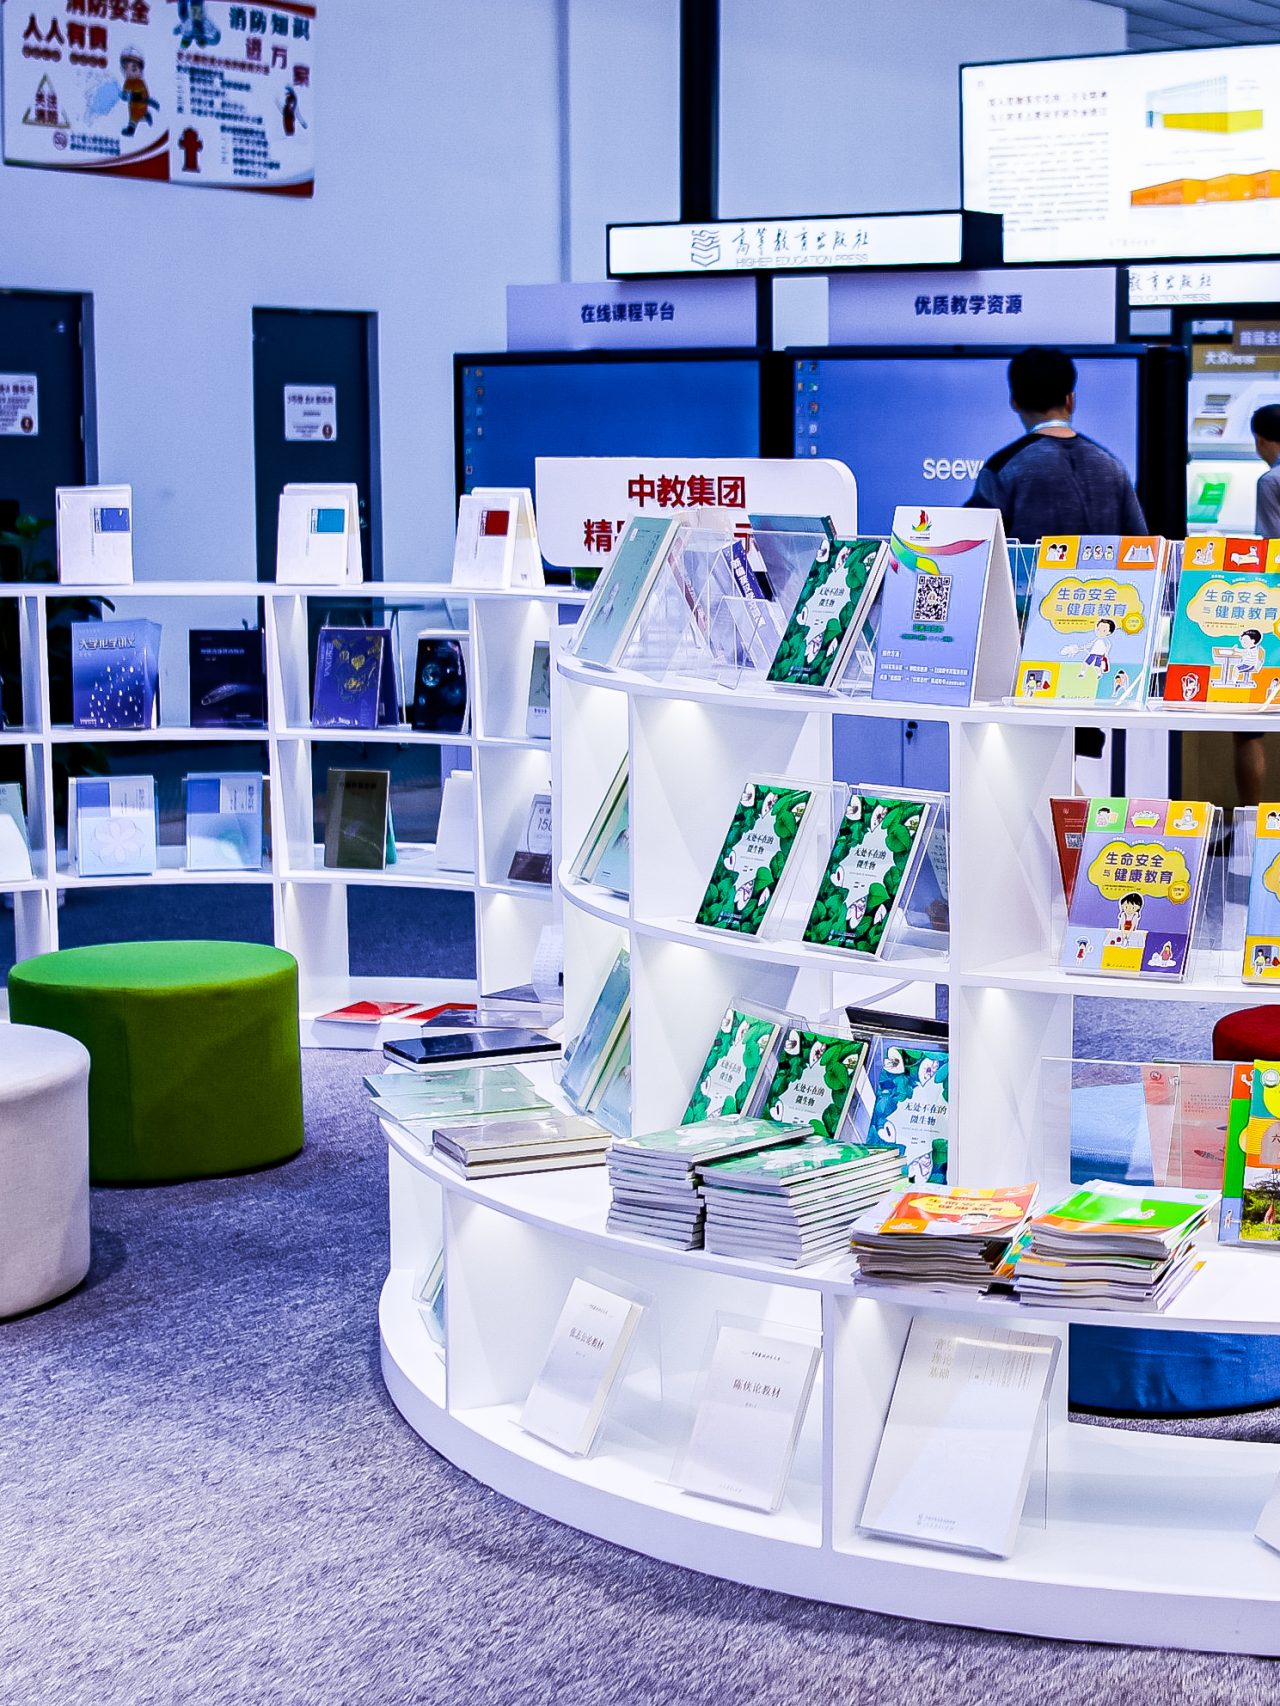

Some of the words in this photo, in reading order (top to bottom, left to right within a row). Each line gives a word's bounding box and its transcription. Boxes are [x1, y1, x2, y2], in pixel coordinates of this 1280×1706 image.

[732, 227, 870, 256] 高等教育出版社
[775, 254, 832, 266] EDUCATION
[834, 253, 869, 265] PRESS
[914, 294, 1023, 316] 优质教学资源
[581, 302, 675, 325] 在线课程平台
[627, 473, 746, 509] 中教集团
[1057, 587, 1118, 602] 生命安全
[1204, 589, 1269, 605] 生命安全
[1055, 602, 1127, 618] 与健康教育
[1202, 604, 1279, 621] 与健康教育
[746, 833, 774, 846] 无处不在的
[746, 844, 764, 856] 微生物
[854, 847, 887, 861] 无处不在的
[856, 859, 876, 871] 微生物
[1105, 851, 1164, 868] 生命安全
[1103, 867, 1174, 885] 与健康教育
[793, 1083, 825, 1098] 无处不在的
[795, 1094, 816, 1107] 微生物
[904, 1103, 948, 1117] 无处不在的
[910, 1114, 937, 1127] 微生物
